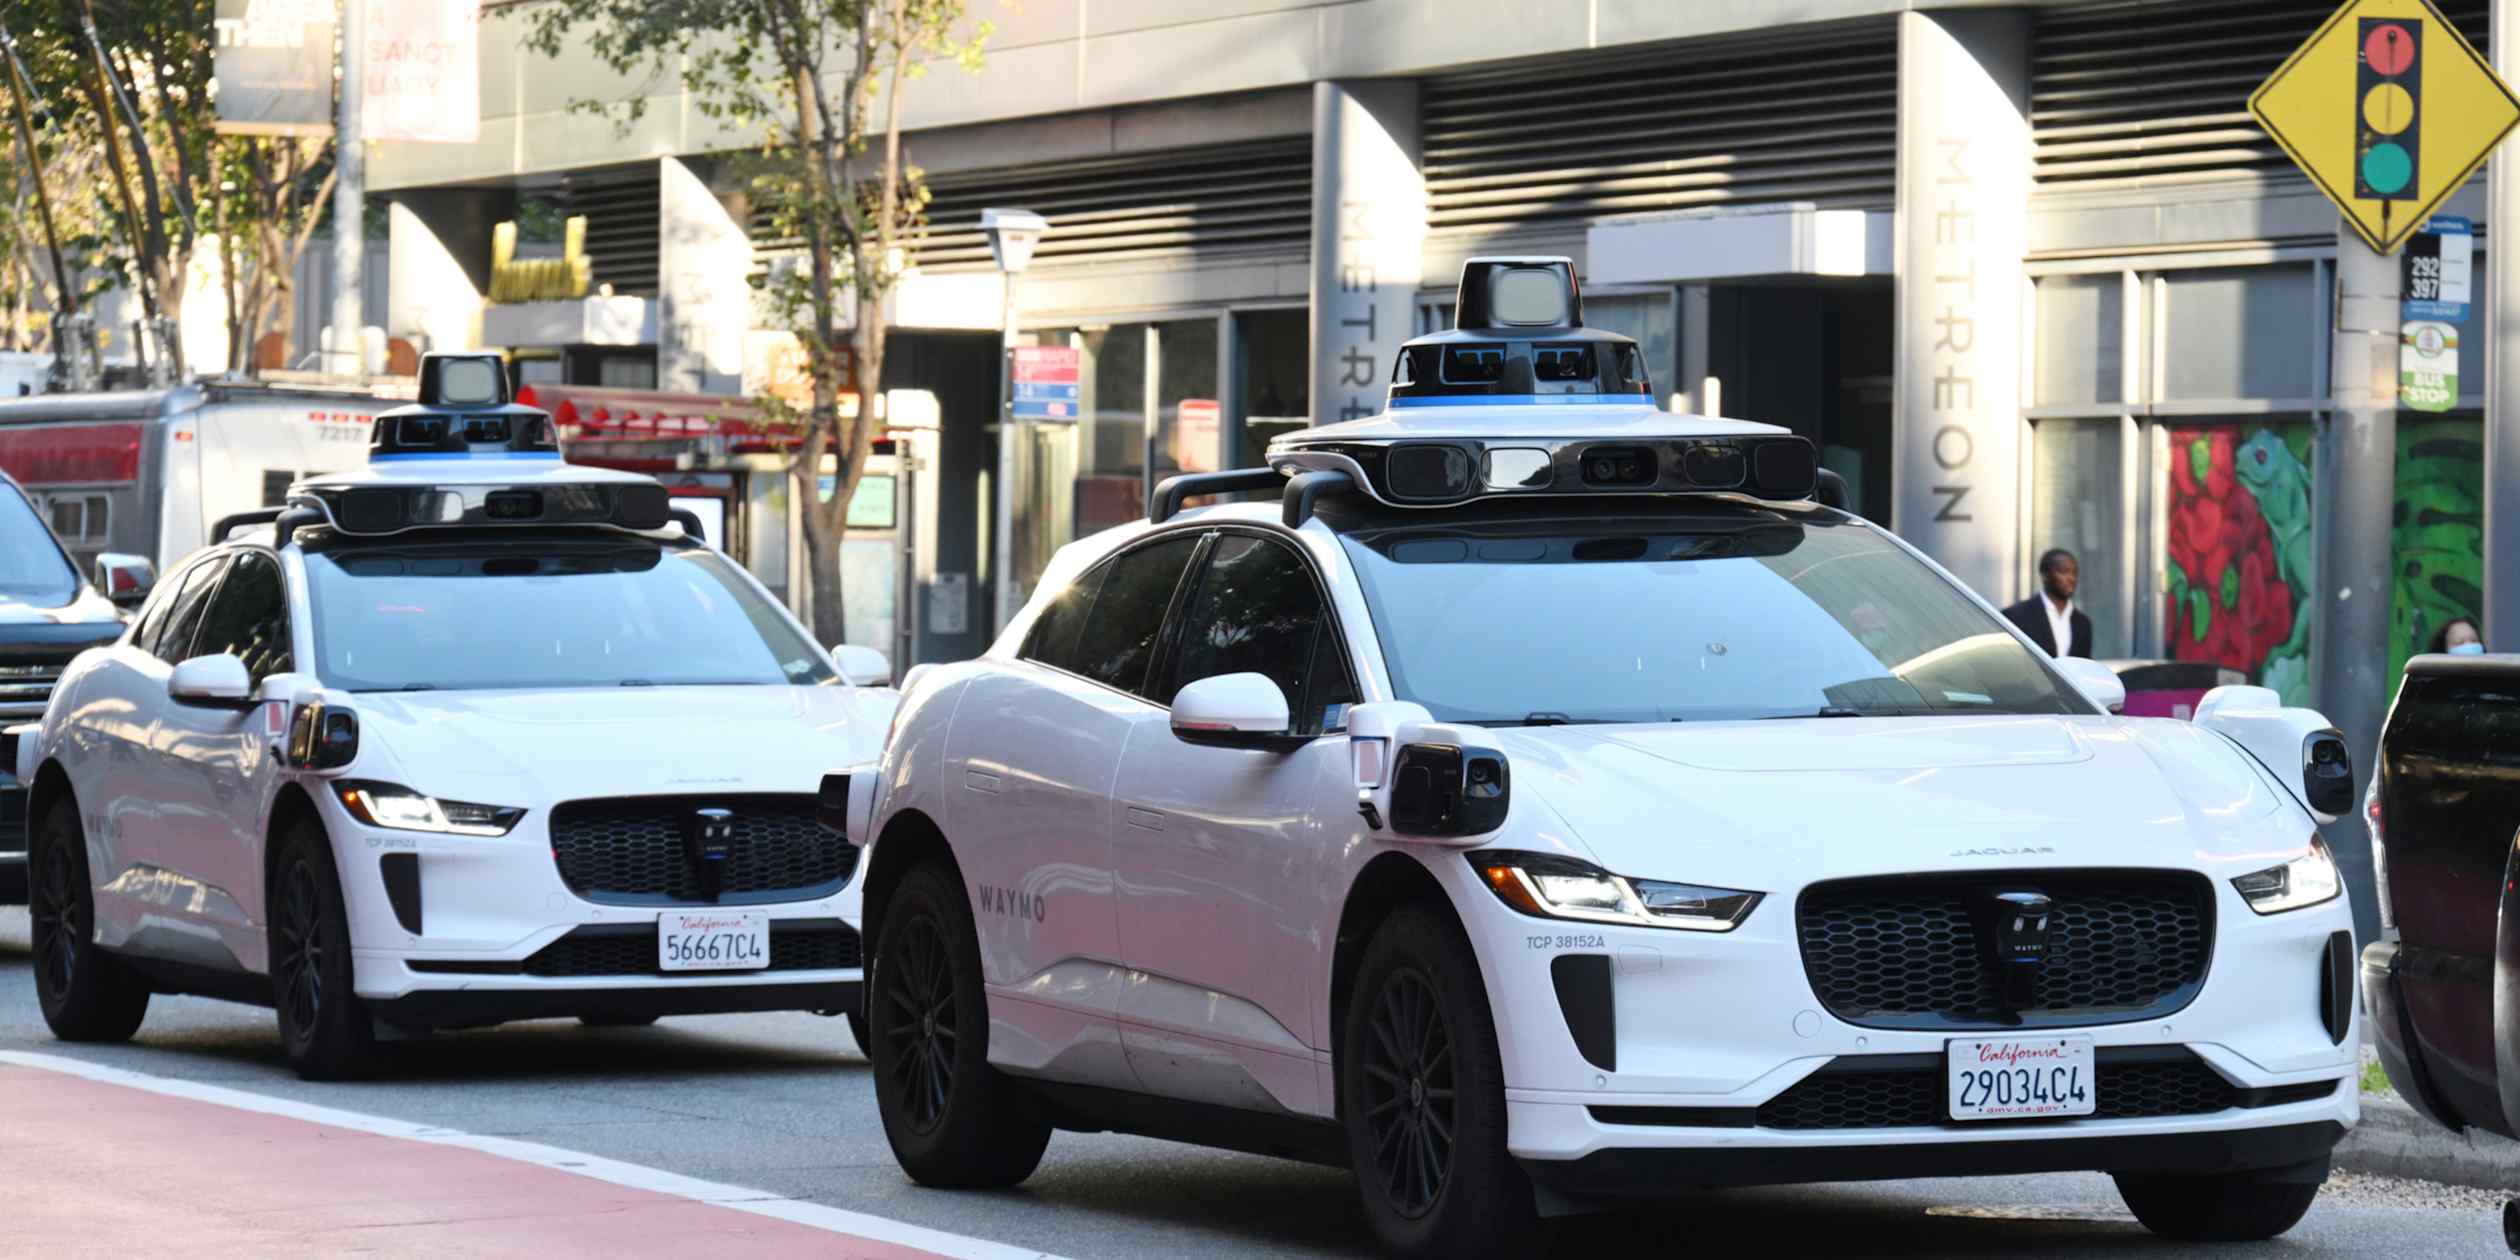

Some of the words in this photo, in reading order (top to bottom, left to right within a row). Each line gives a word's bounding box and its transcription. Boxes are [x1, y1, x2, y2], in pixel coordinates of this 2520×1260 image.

[2411, 256, 2440, 277] 292
[2411, 278, 2439, 299] 397
[1932, 138, 1974, 523] METREON
[2410, 387, 2450, 403] STOP
[979, 884, 1046, 924] WAYMO
[680, 916, 746, 932] California
[667, 932, 761, 961] 56667C4
[1526, 935, 1553, 950] TCP
[1555, 935, 1605, 949] 38152A
[1979, 1043, 2067, 1066] California
[1960, 1065, 2086, 1107] 29034C4
[1986, 1104, 2060, 1114] dmv.ca.gov
